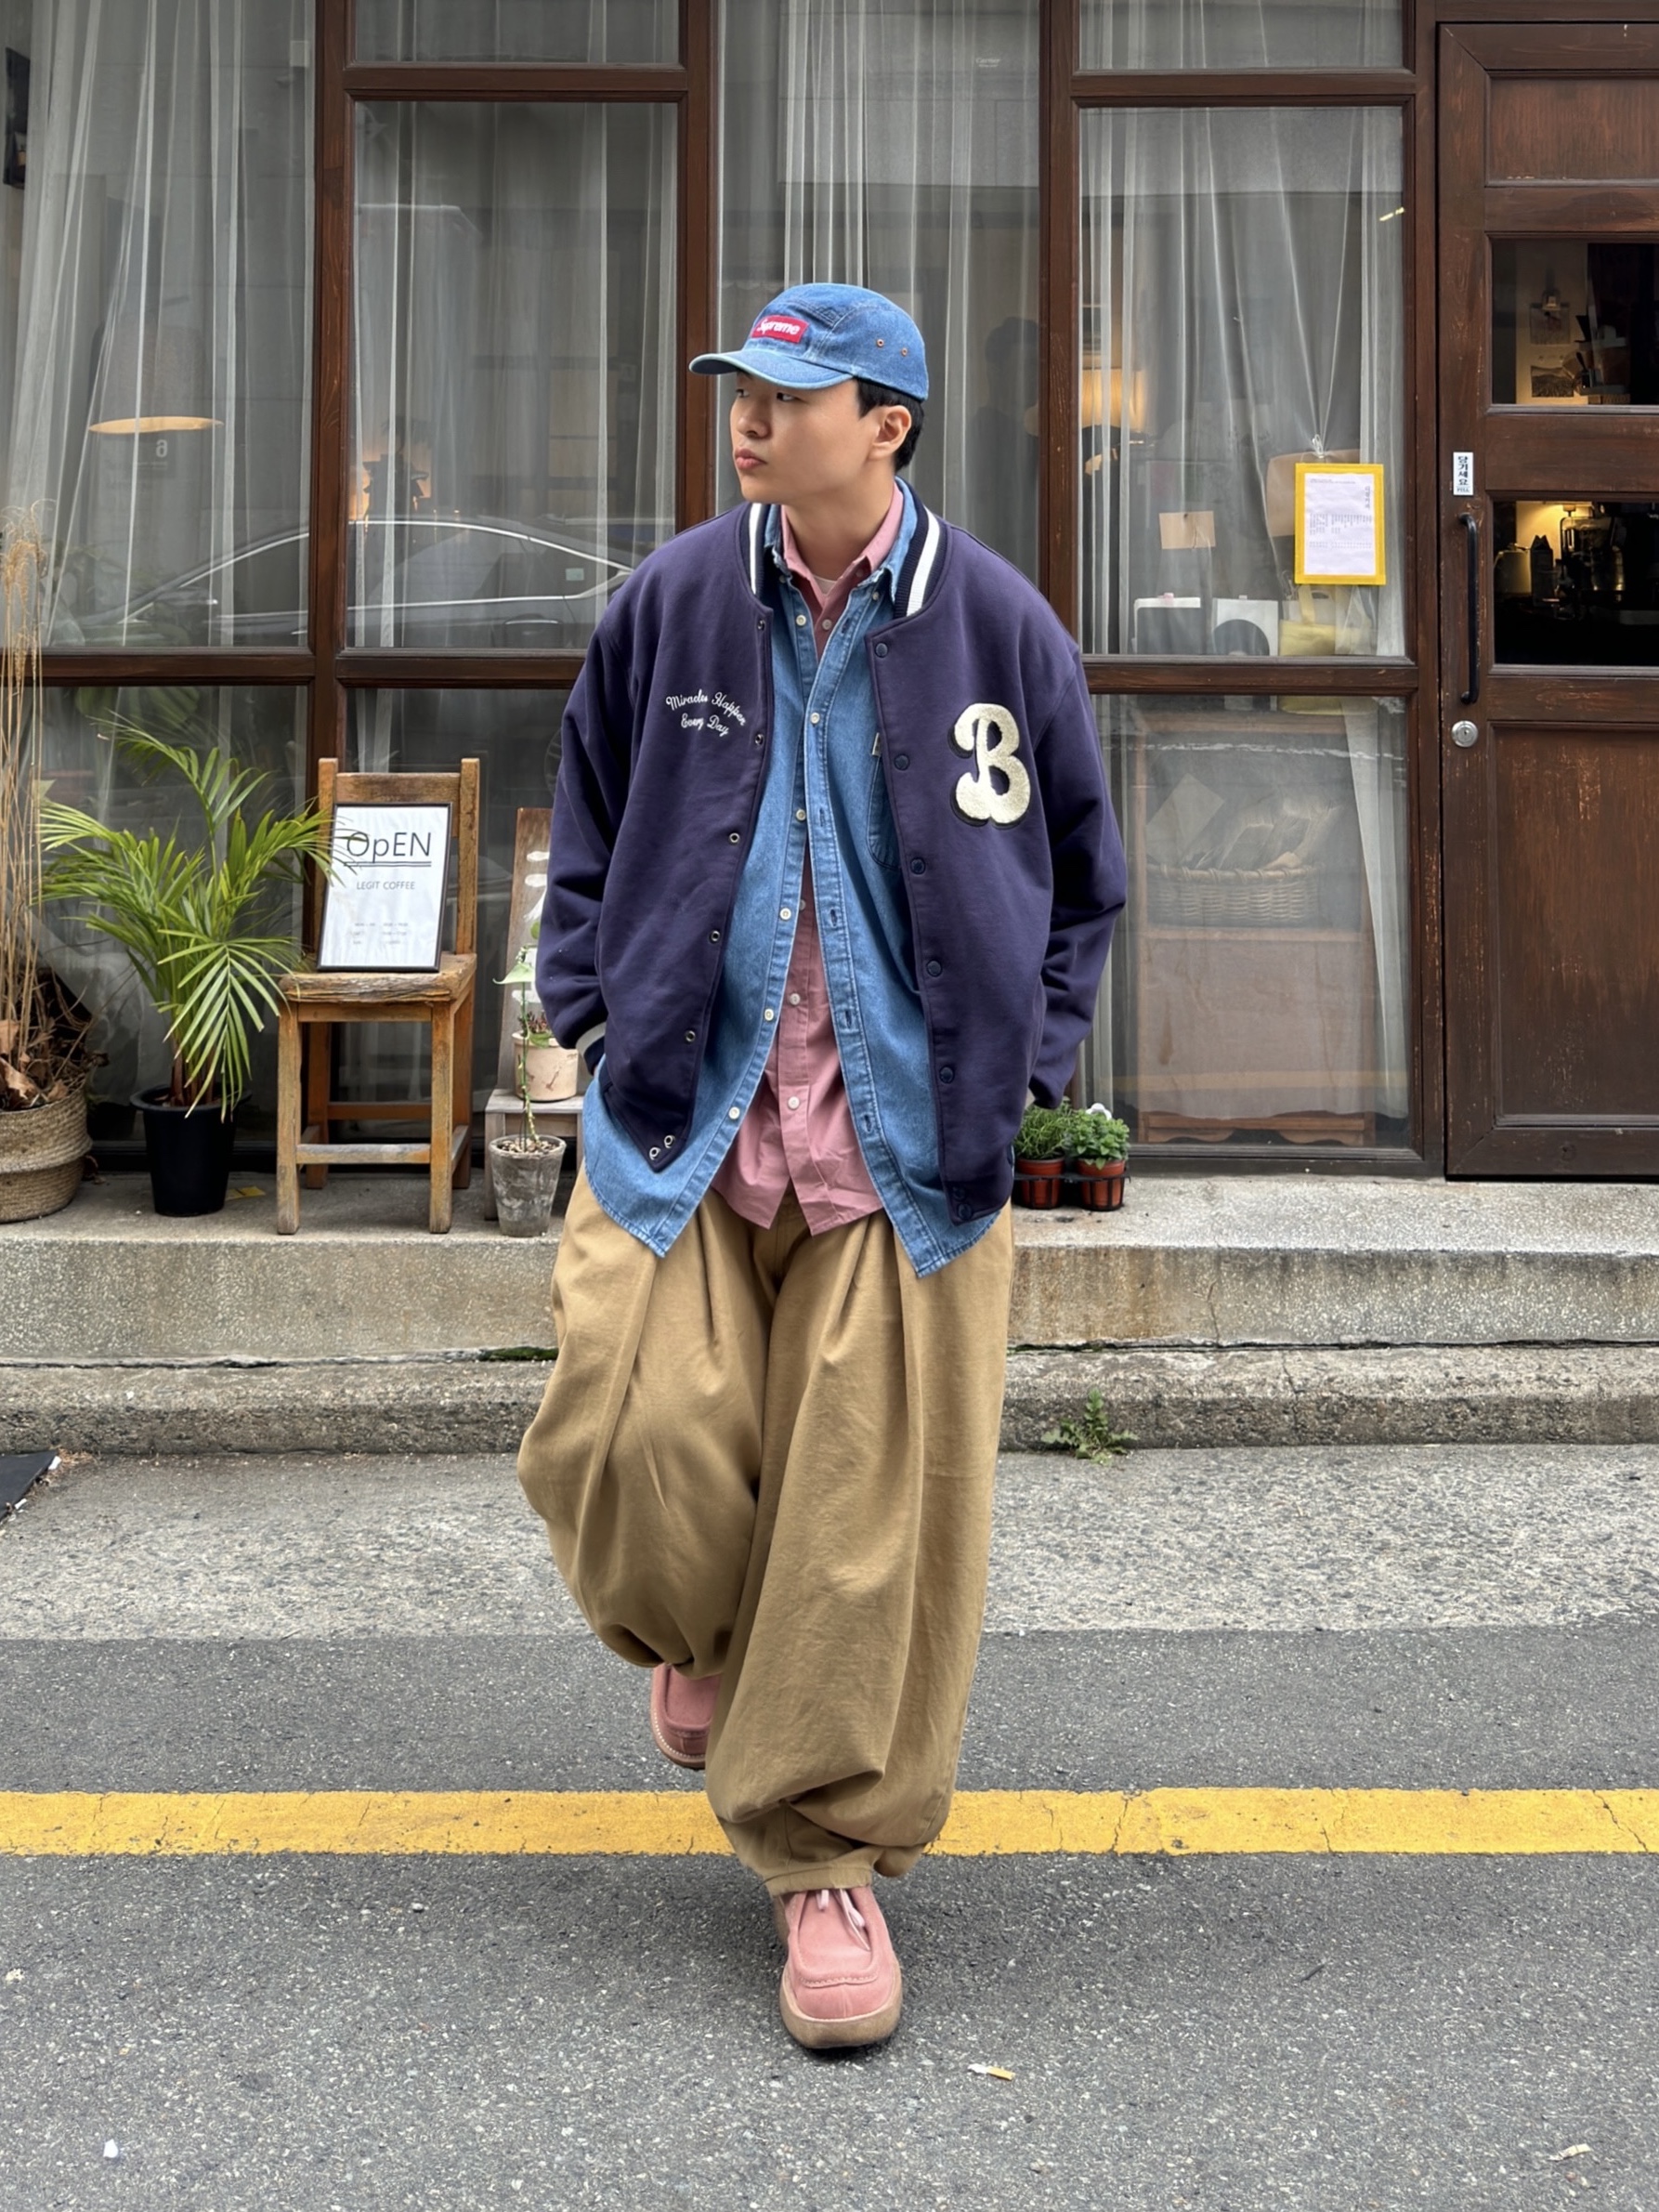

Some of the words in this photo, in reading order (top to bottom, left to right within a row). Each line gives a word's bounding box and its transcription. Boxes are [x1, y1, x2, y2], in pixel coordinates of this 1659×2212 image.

[1457, 455, 1469, 485] 당기세요
[665, 688, 708, 711] Miracles
[712, 691, 747, 726] Happen
[680, 713, 704, 731] Every
[707, 714, 730, 737] Day
[950, 702, 1031, 829] B
[356, 881, 380, 891] LEGIT
[383, 881, 416, 891] COFFEE
